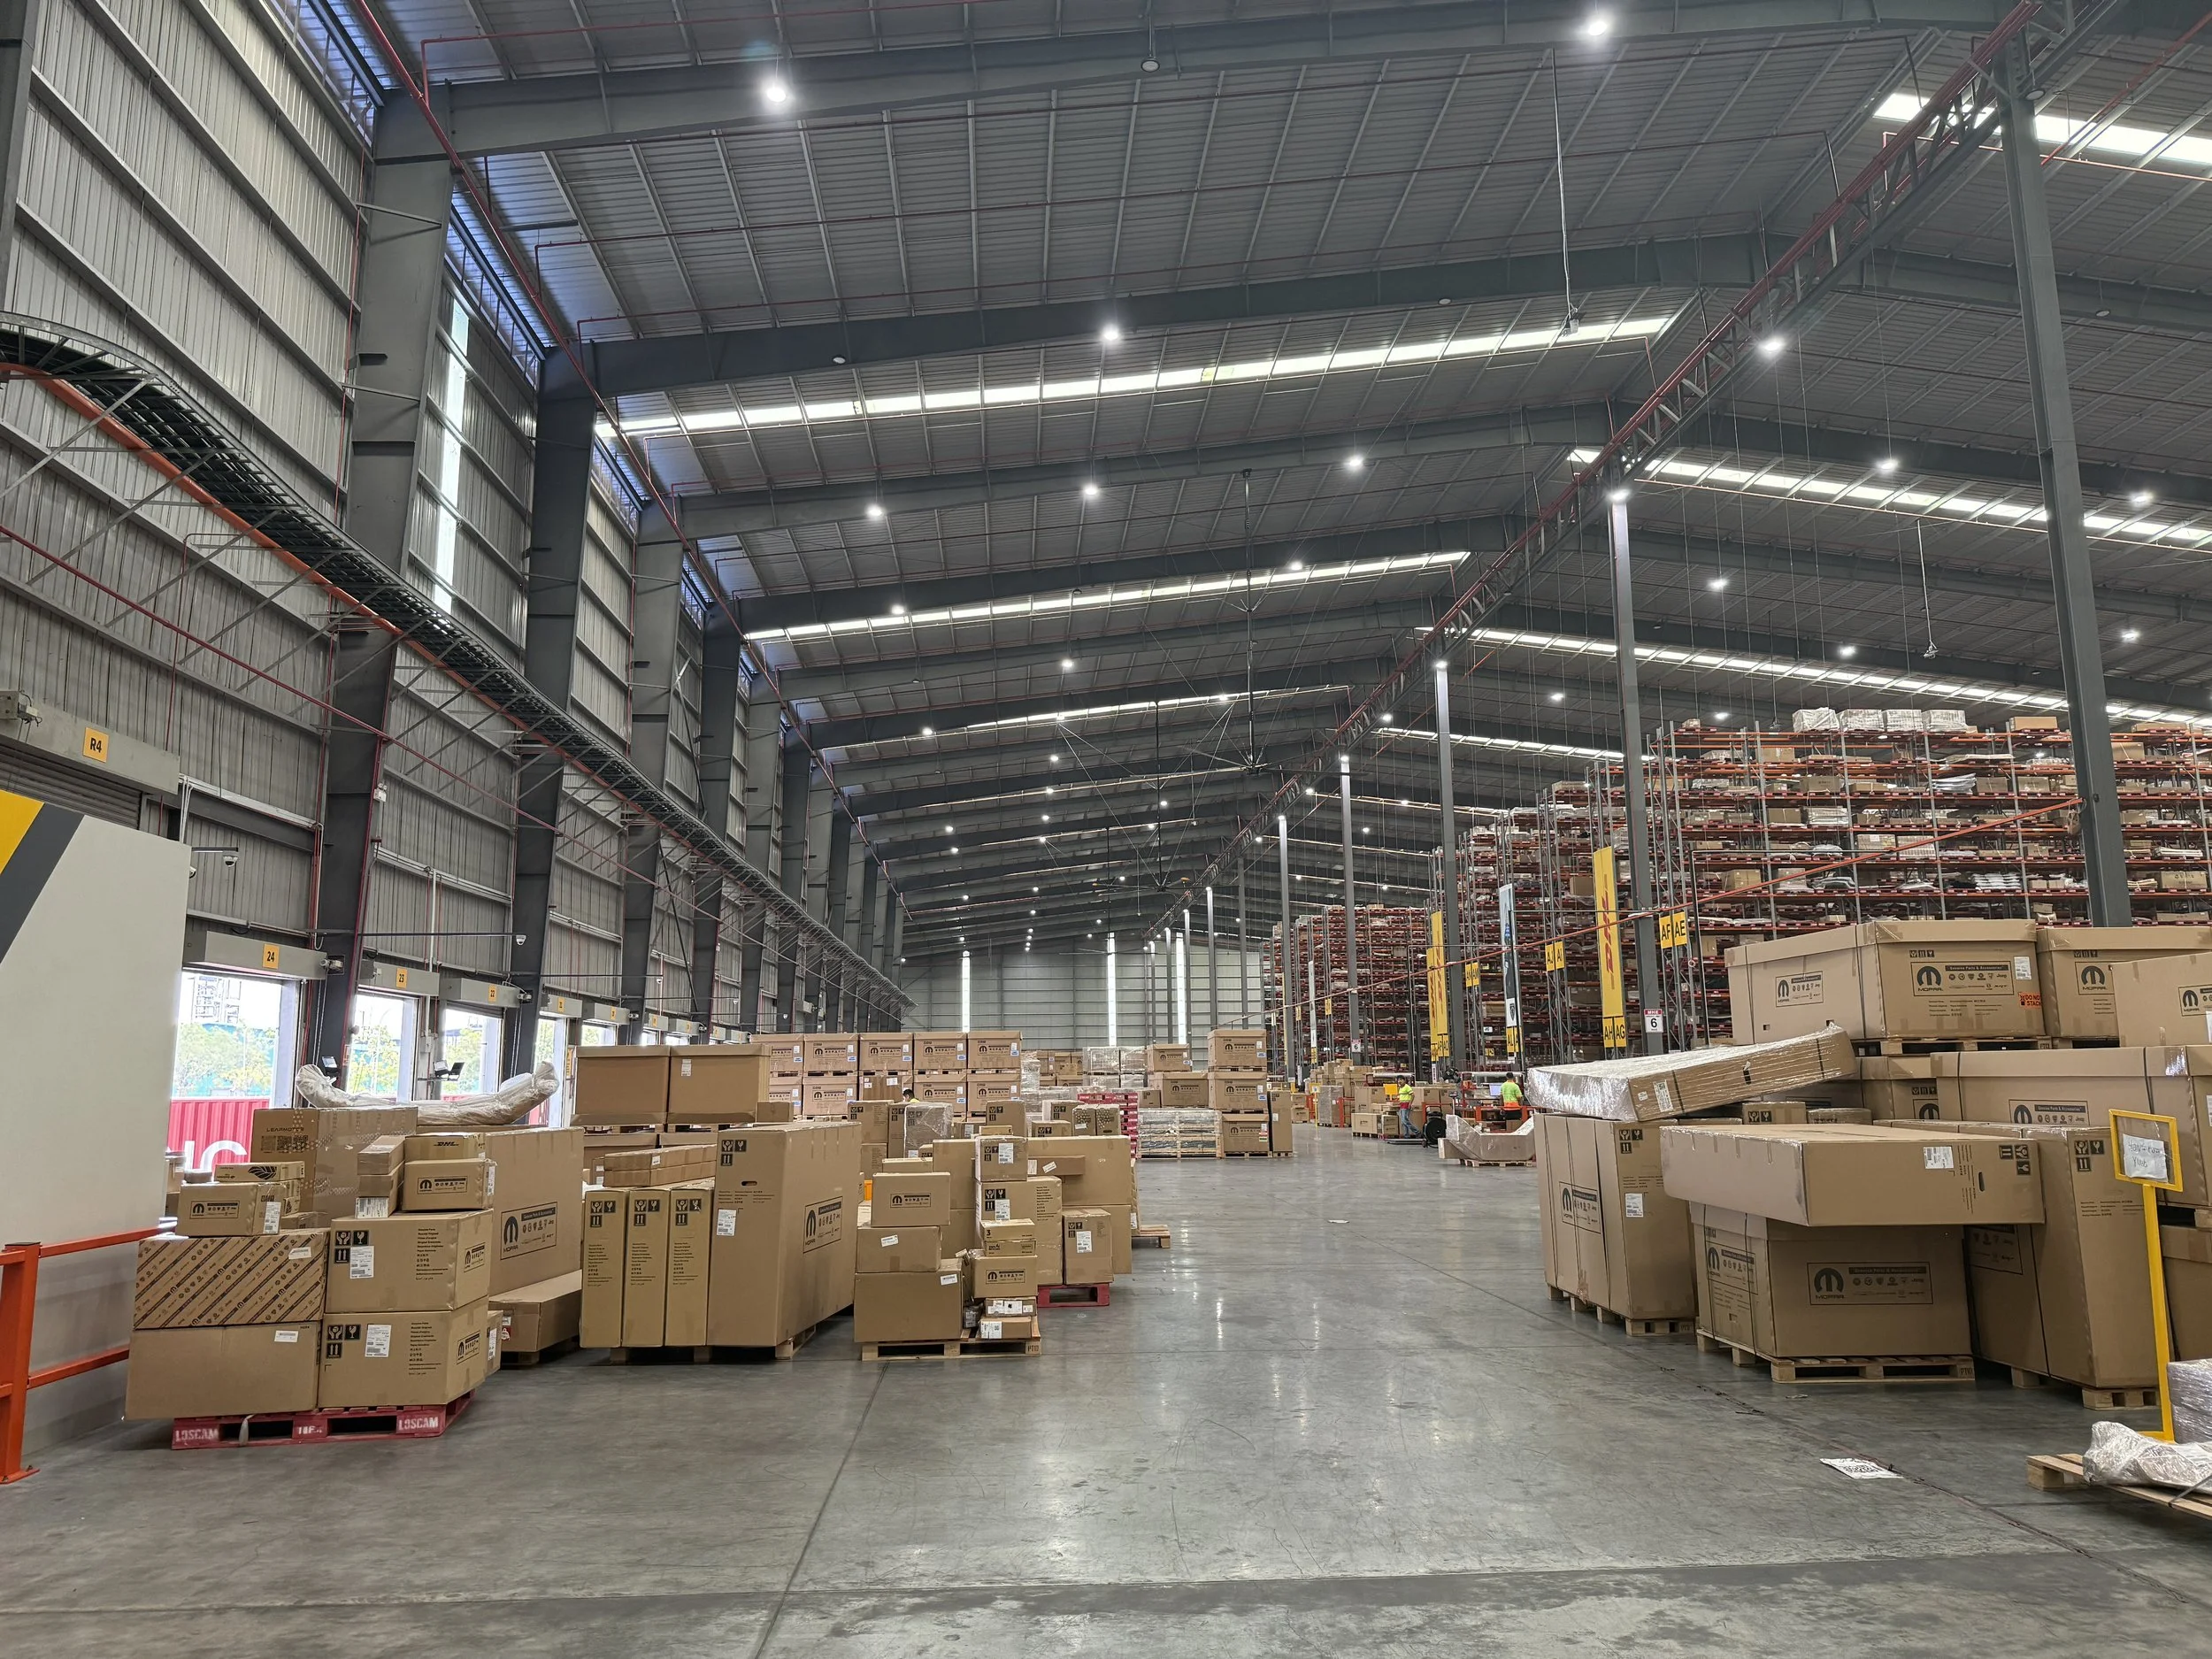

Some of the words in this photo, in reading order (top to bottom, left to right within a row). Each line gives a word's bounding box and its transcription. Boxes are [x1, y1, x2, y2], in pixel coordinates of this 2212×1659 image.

[90, 737, 103, 753] R4
[1661, 923, 1671, 941] AF
[1675, 920, 1686, 938] AE
[266, 950, 275, 962] 24
[398, 973, 404, 983] 23
[1650, 1018, 1657, 1028] 6
[1603, 1025, 1613, 1040] AH
[1615, 1024, 1625, 1039] AG
[397, 1415, 439, 1431] LOSCAM
[175, 1426, 219, 1442] LOSCAM
